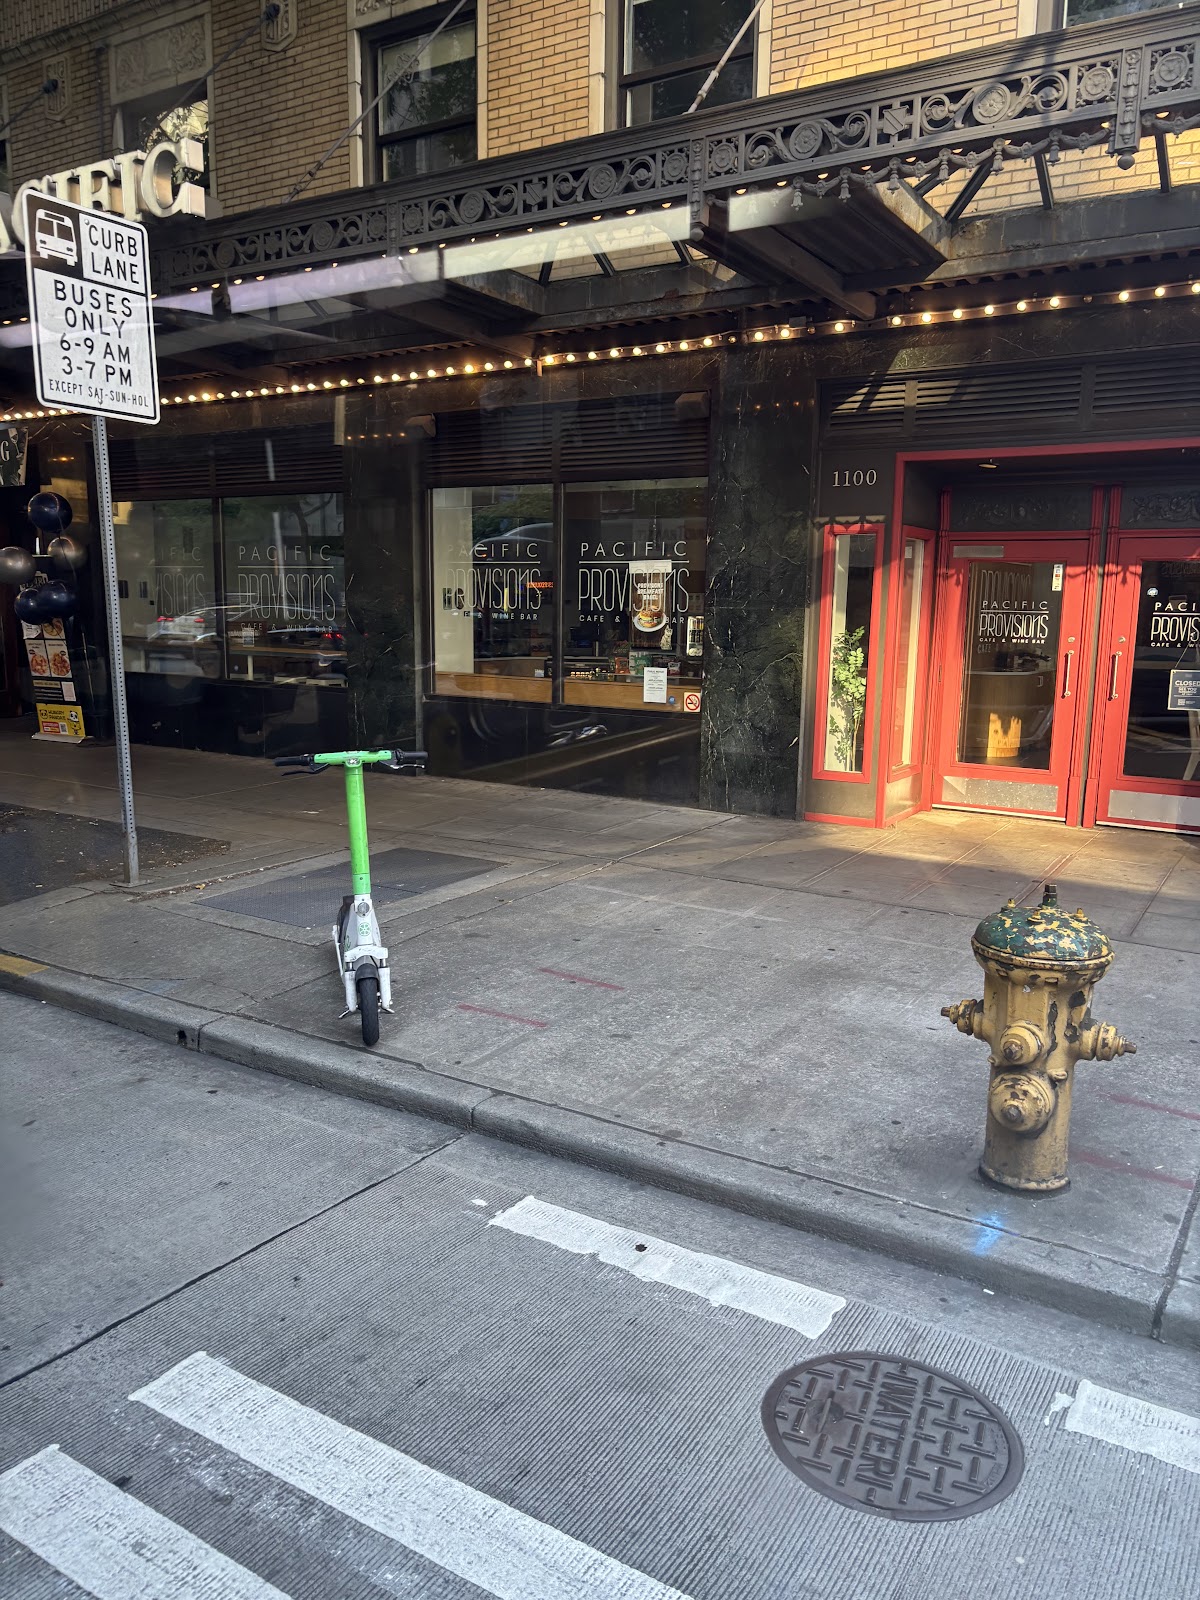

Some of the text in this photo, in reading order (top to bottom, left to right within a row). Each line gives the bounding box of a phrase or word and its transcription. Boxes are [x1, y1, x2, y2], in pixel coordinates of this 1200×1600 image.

[88, 224, 138, 257] CURB
[91, 251, 140, 285] LANE
[53, 279, 133, 318] BUSES
[64, 307, 125, 339] ONLY
[60, 332, 131, 364] 6-9 AM
[62, 355, 132, 387] 3-7 PM
[48, 378, 149, 408] EXCEPT SAT-SUN-HOL
[832, 469, 877, 487] 1100
[239, 544, 331, 561] PACIFIC
[448, 543, 538, 558] PACIFIC
[580, 540, 687, 557] PACIFIC
[237, 573, 336, 621] PROVISIONS
[445, 568, 541, 610] PROVISIONS
[578, 568, 690, 613] PROVISIONS
[982, 600, 1049, 610] PACIFIC
[579, 615, 604, 623] CAFE
[614, 615, 621, 623] &
[665, 616, 685, 624] BAR
[978, 613, 1049, 639] PROVISIONS
[857, 1381, 918, 1478] WATER
